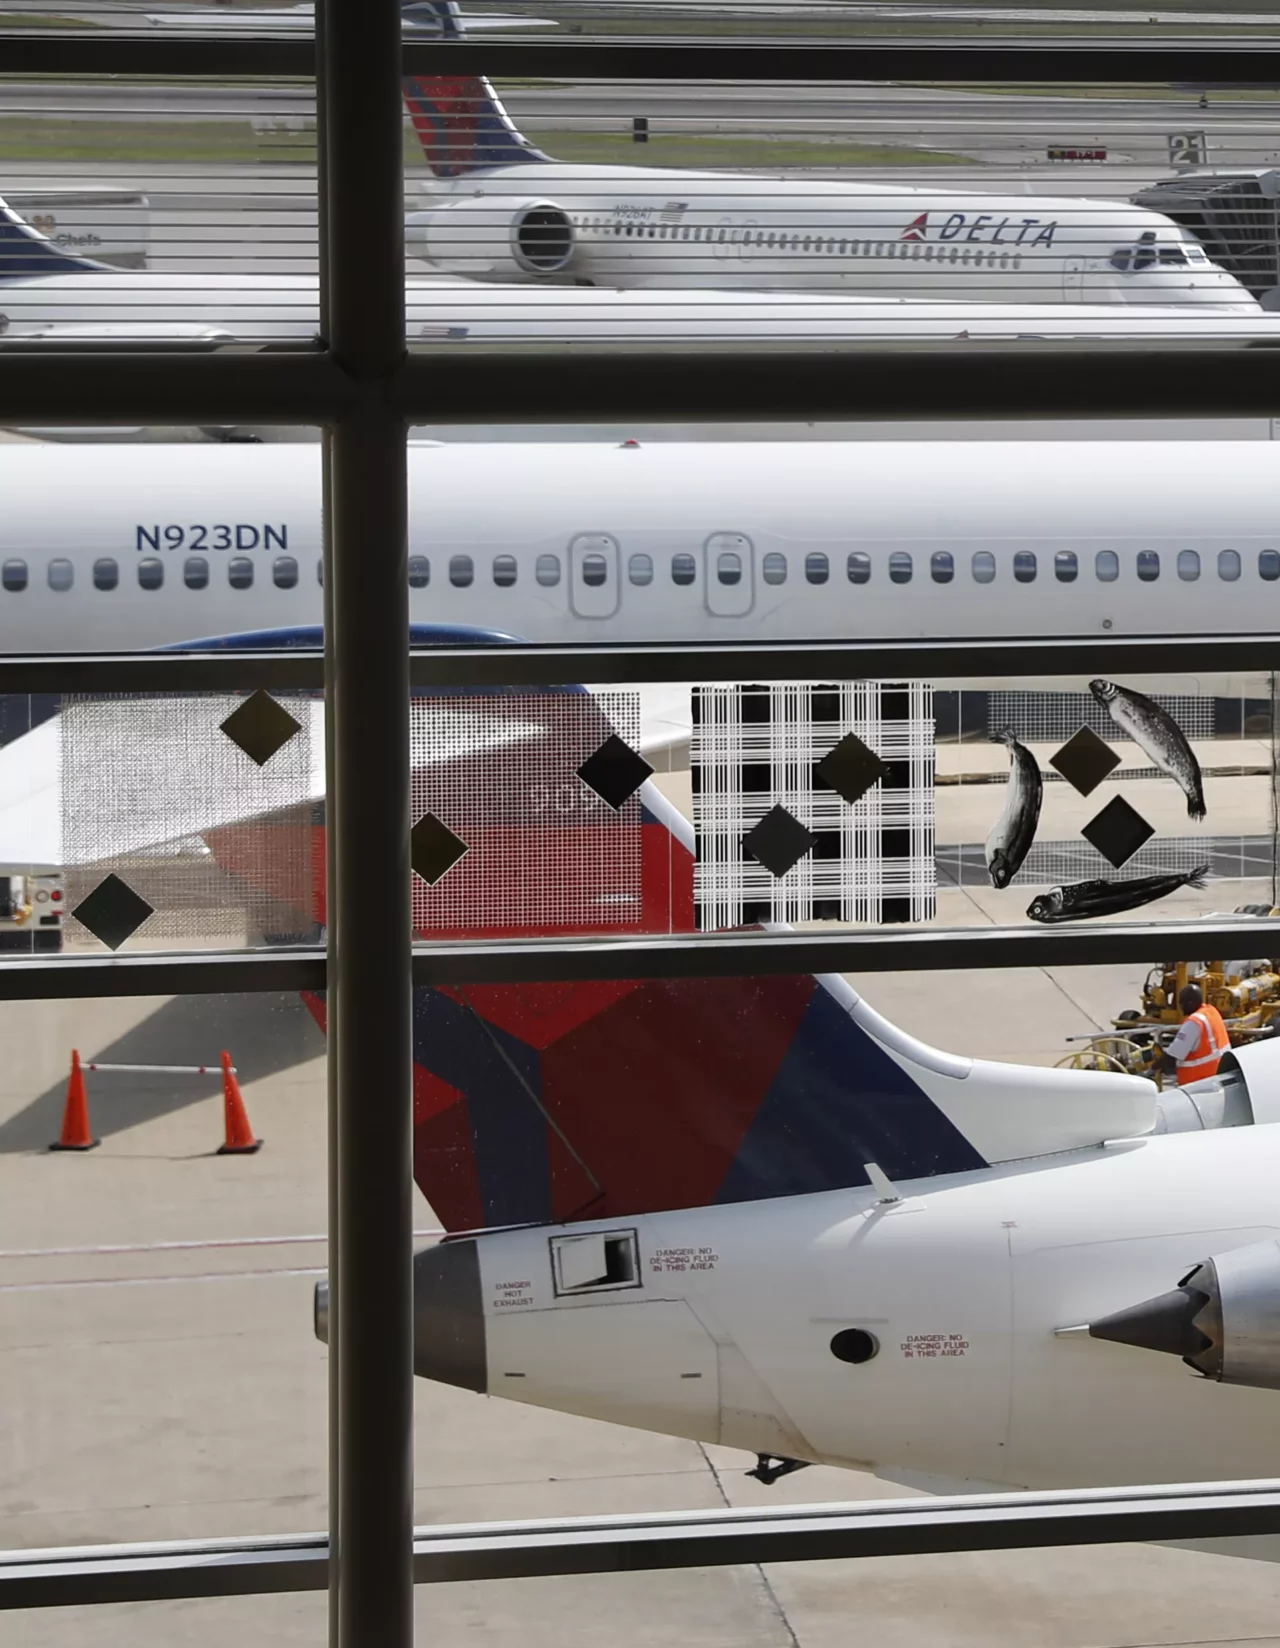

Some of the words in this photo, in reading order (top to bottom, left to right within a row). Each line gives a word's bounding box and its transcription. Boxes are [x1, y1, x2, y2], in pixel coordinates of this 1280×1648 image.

[1171, 135, 1204, 164] 21
[938, 213, 1058, 249] DELTA
[57, 233, 101, 246] Chefs
[135, 524, 289, 551] N923DN
[699, 1247, 713, 1255] NO
[650, 1256, 690, 1264] DE-ICING
[495, 1281, 531, 1290] DANGER
[504, 1290, 522, 1298] HOT
[493, 1297, 534, 1307] EXHAUST
[949, 1333, 963, 1341] NO
[901, 1342, 941, 1350] DE-ICING
[944, 1341, 969, 1349] FLUID
